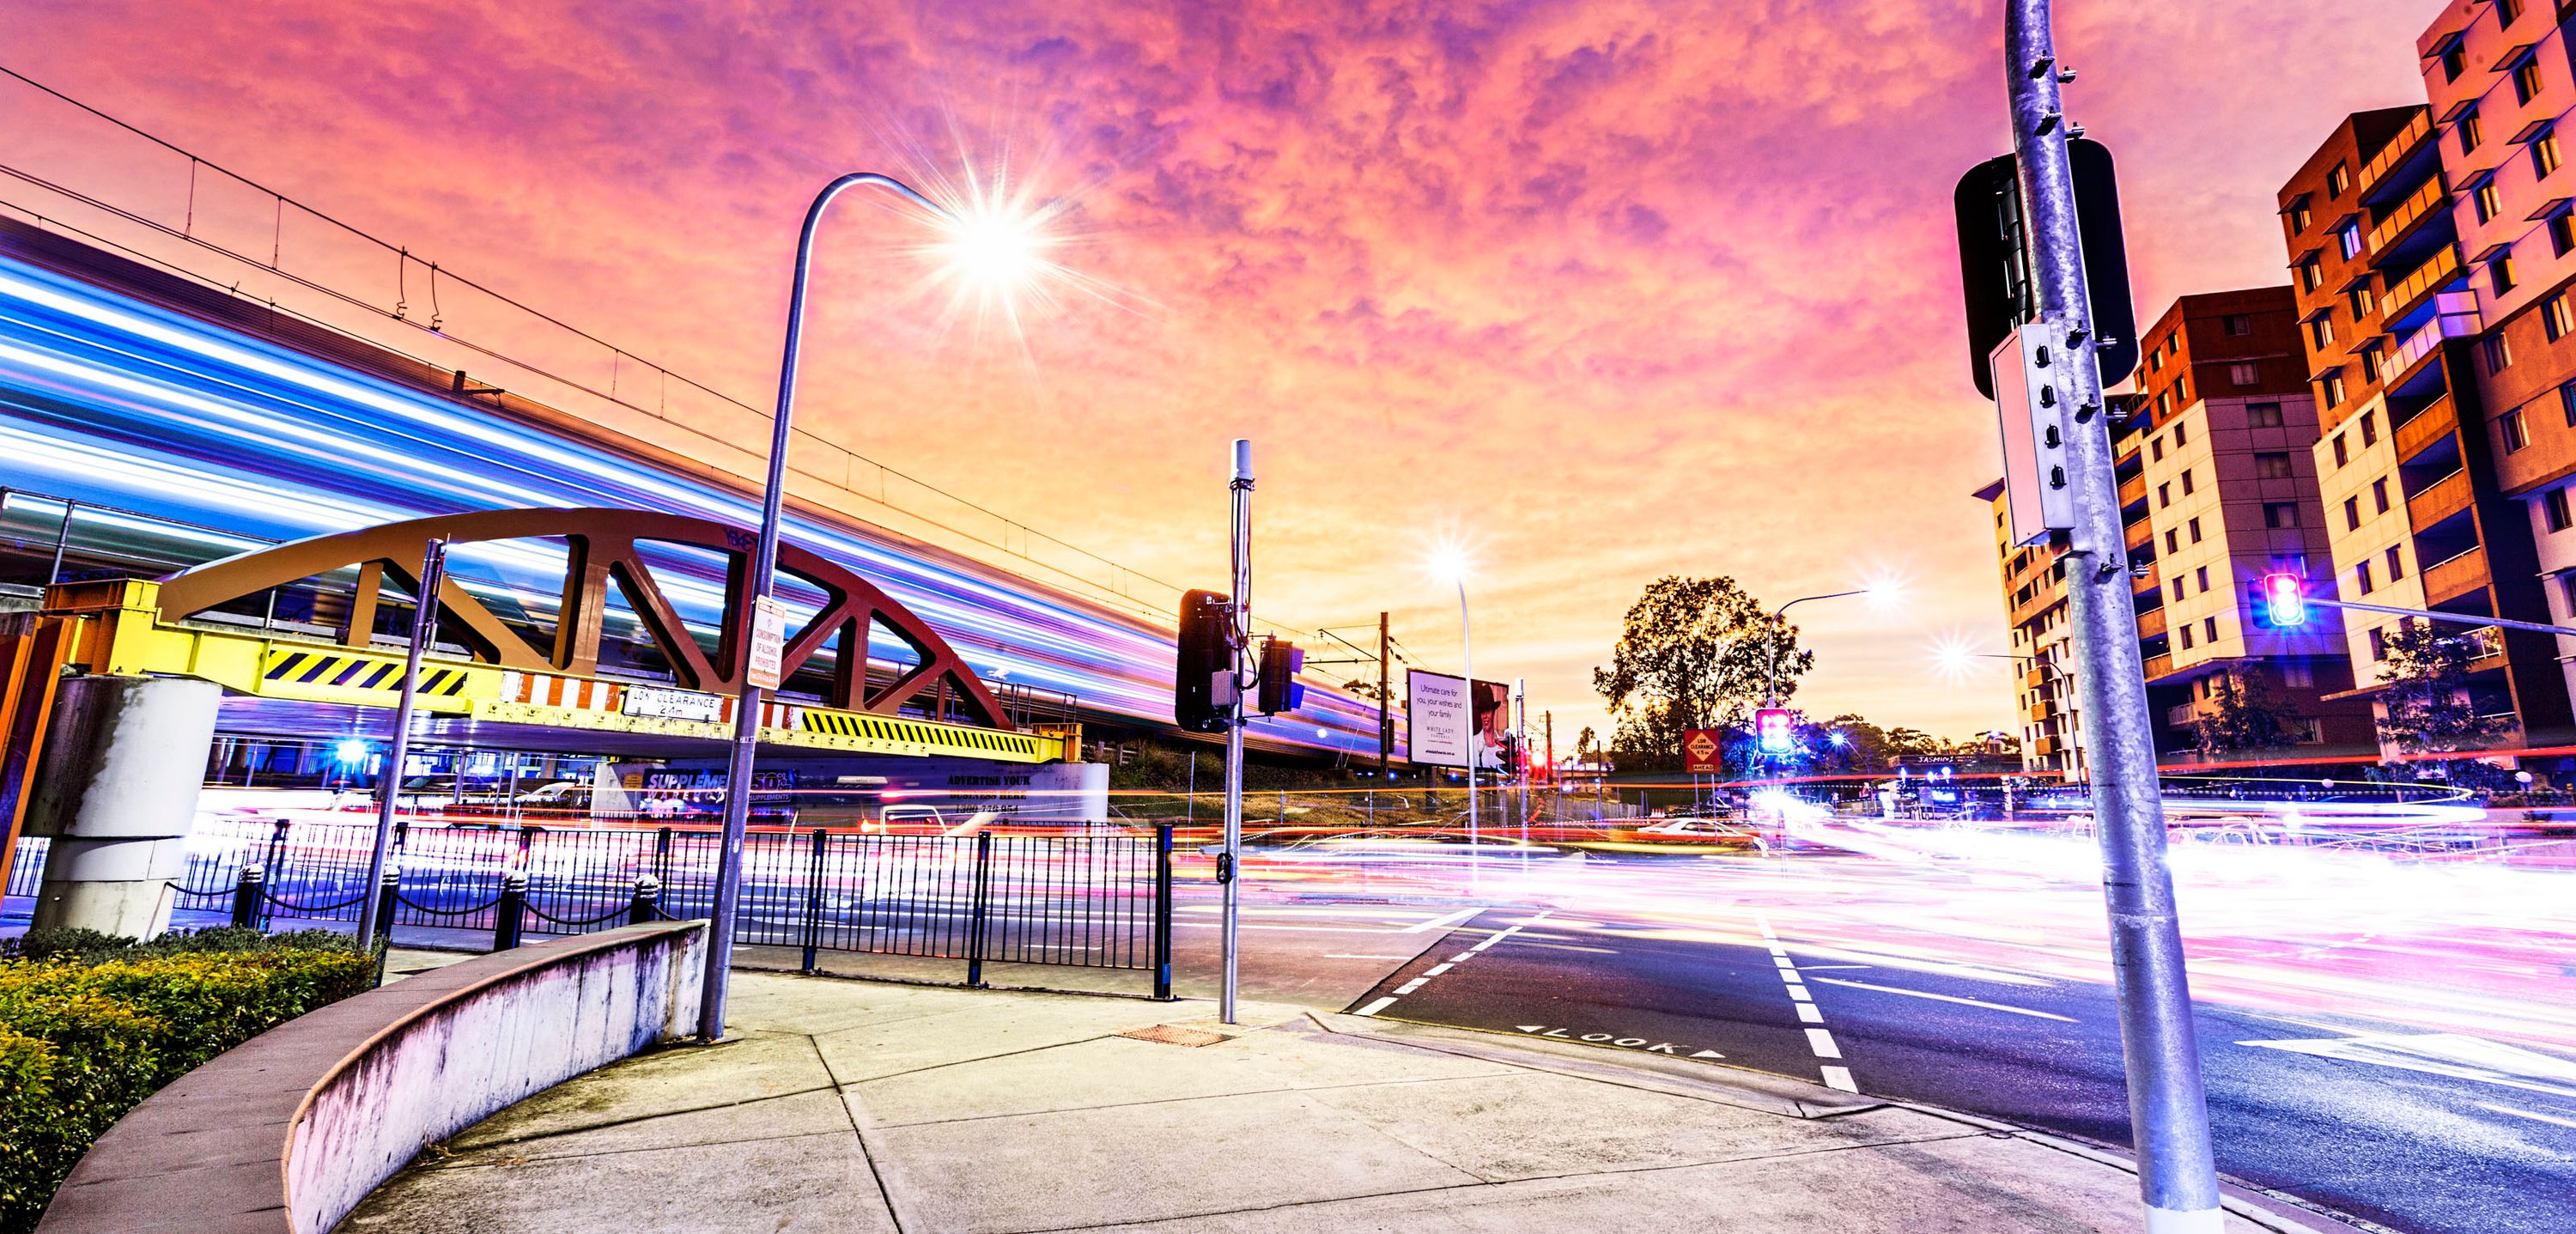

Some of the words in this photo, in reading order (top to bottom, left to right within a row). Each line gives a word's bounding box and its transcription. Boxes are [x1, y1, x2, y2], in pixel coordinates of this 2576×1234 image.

[1420, 684, 1440, 695] Ultimate
[1440, 688, 1450, 696] care
[634, 690, 650, 701] LOW
[657, 693, 715, 708] CLEARANCE
[1427, 698, 1438, 707] your
[1438, 699, 1453, 708] wishes
[1428, 709, 1438, 719] your
[1439, 709, 1452, 720] family
[648, 774, 728, 789] SUPPLEME
[948, 775, 1001, 786] ADVERTISE
[1003, 775, 1030, 786] YOUR
[1542, 1028, 1690, 1055] LOOK
